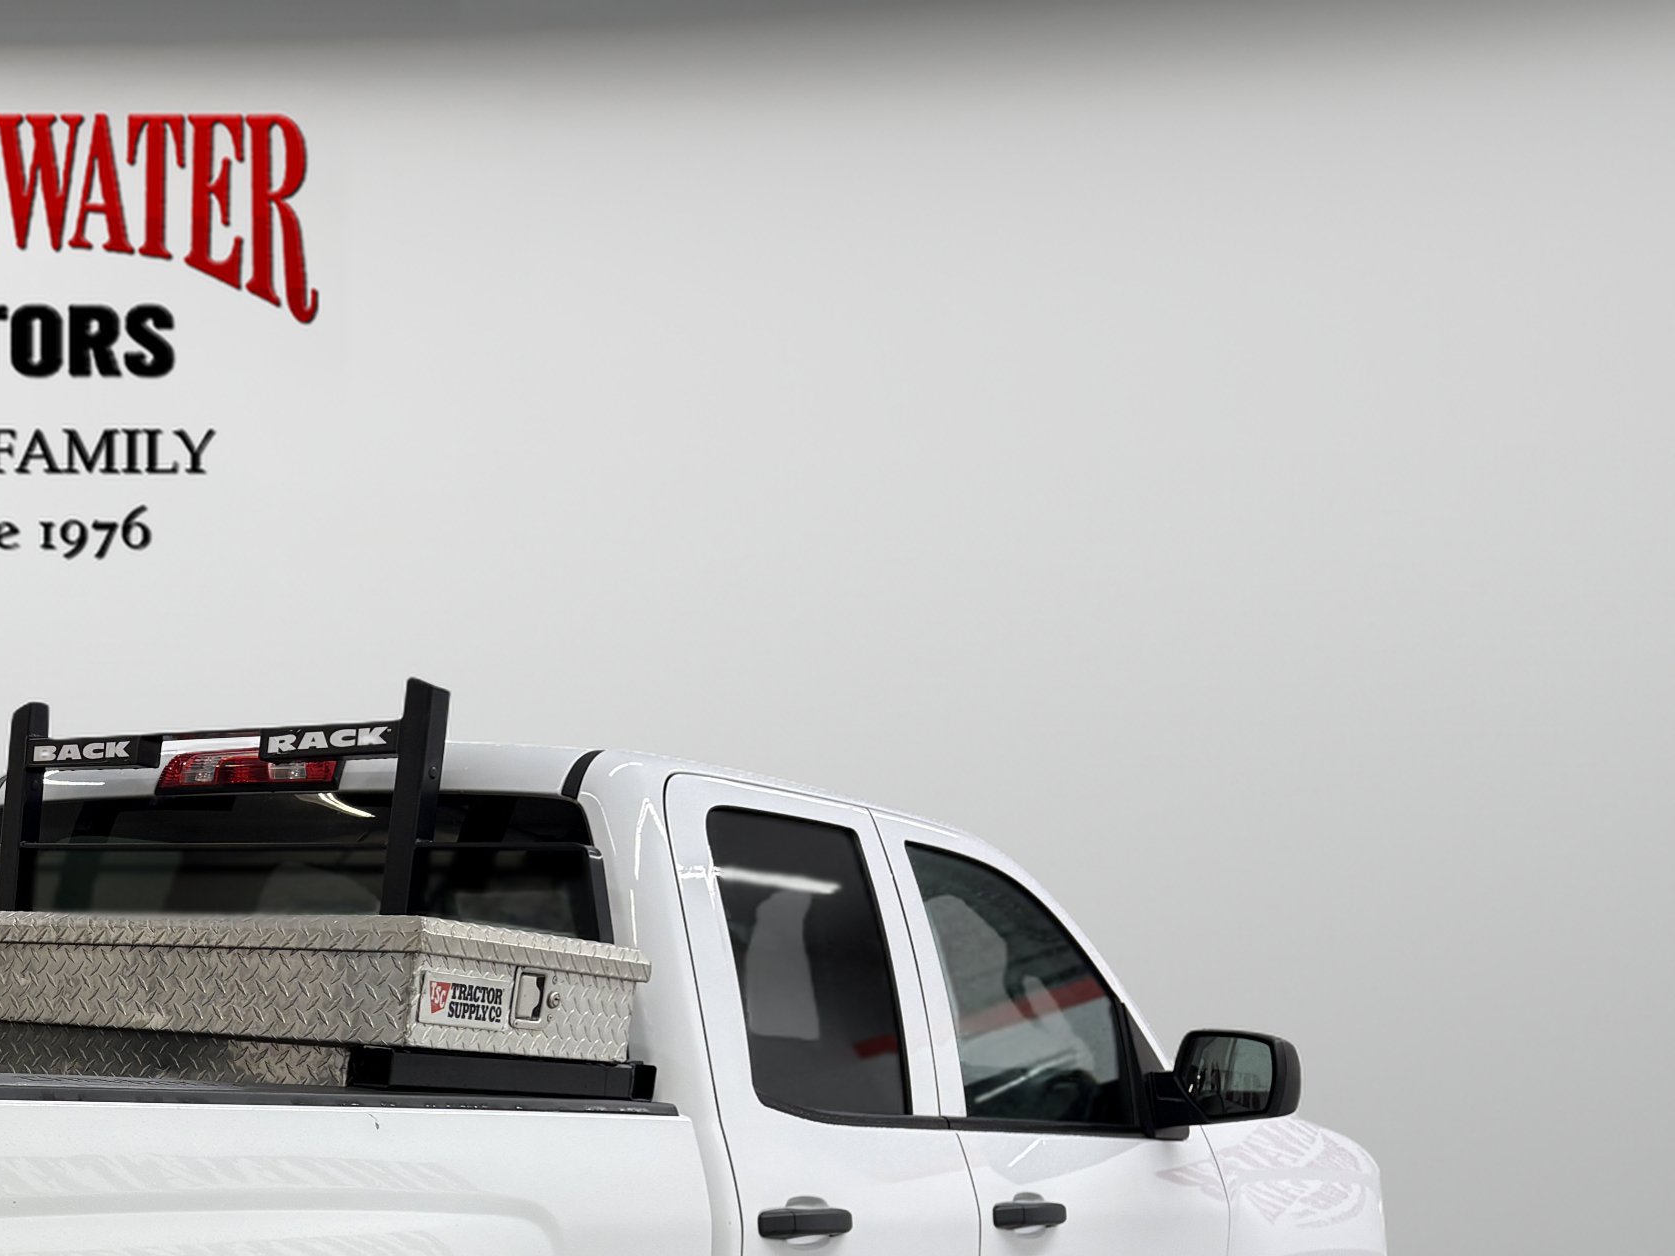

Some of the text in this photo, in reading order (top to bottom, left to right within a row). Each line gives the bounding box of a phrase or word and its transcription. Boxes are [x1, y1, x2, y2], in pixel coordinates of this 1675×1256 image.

[39, 504, 153, 560] 1976
[32, 726, 388, 764] BACK RACK
[450, 983, 503, 1006] TRACTOR
[447, 1001, 489, 1022] SUPPLY
